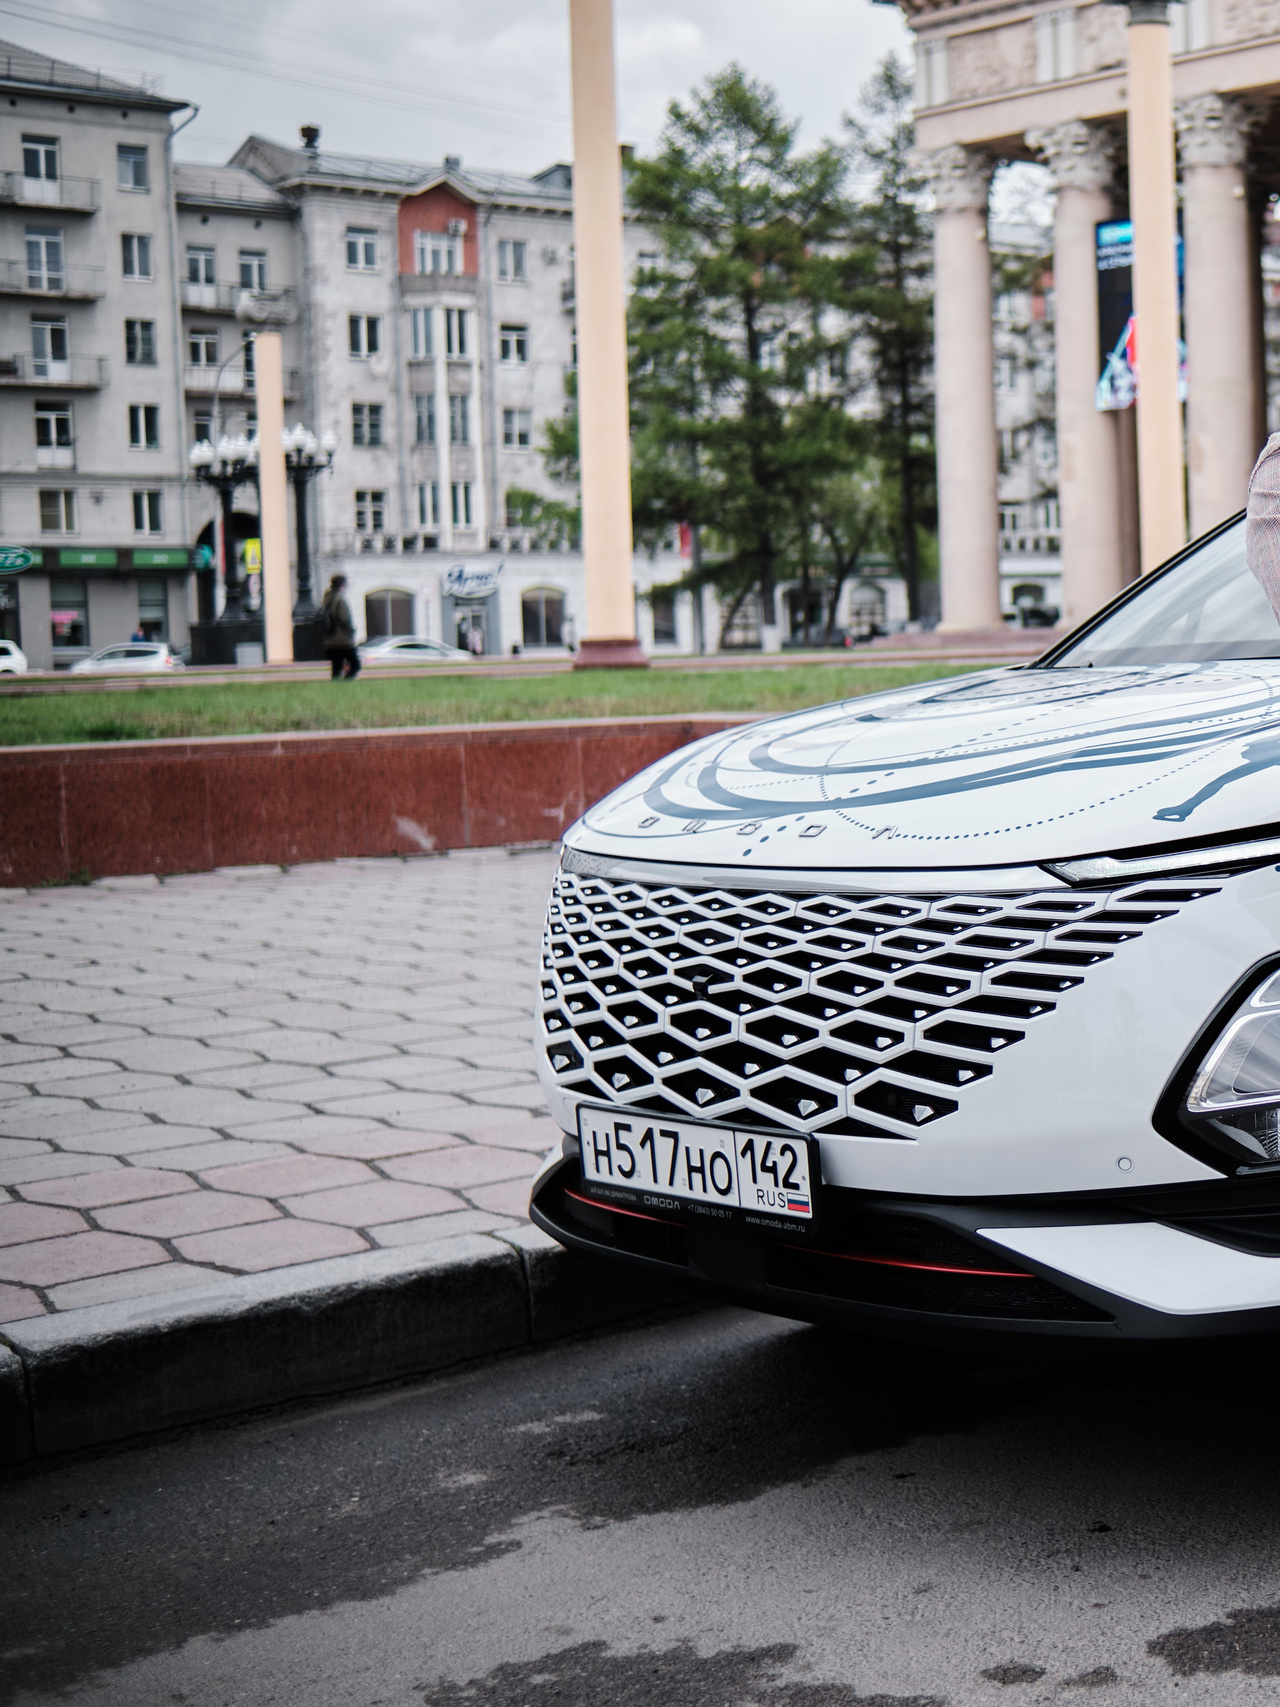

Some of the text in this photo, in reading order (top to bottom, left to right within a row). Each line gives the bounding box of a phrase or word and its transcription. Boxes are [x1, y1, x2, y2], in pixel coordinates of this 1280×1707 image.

[740, 1138, 800, 1190] 142
[643, 1195, 681, 1210] OMODA
[756, 1188, 787, 1209] RUS
[694, 1205, 711, 1217] (3843)
[710, 1208, 718, 1217] 50
[718, 1210, 725, 1218] 05
[725, 1211, 732, 1219] 17
[745, 1215, 806, 1233] www.omoda-abm.ru
